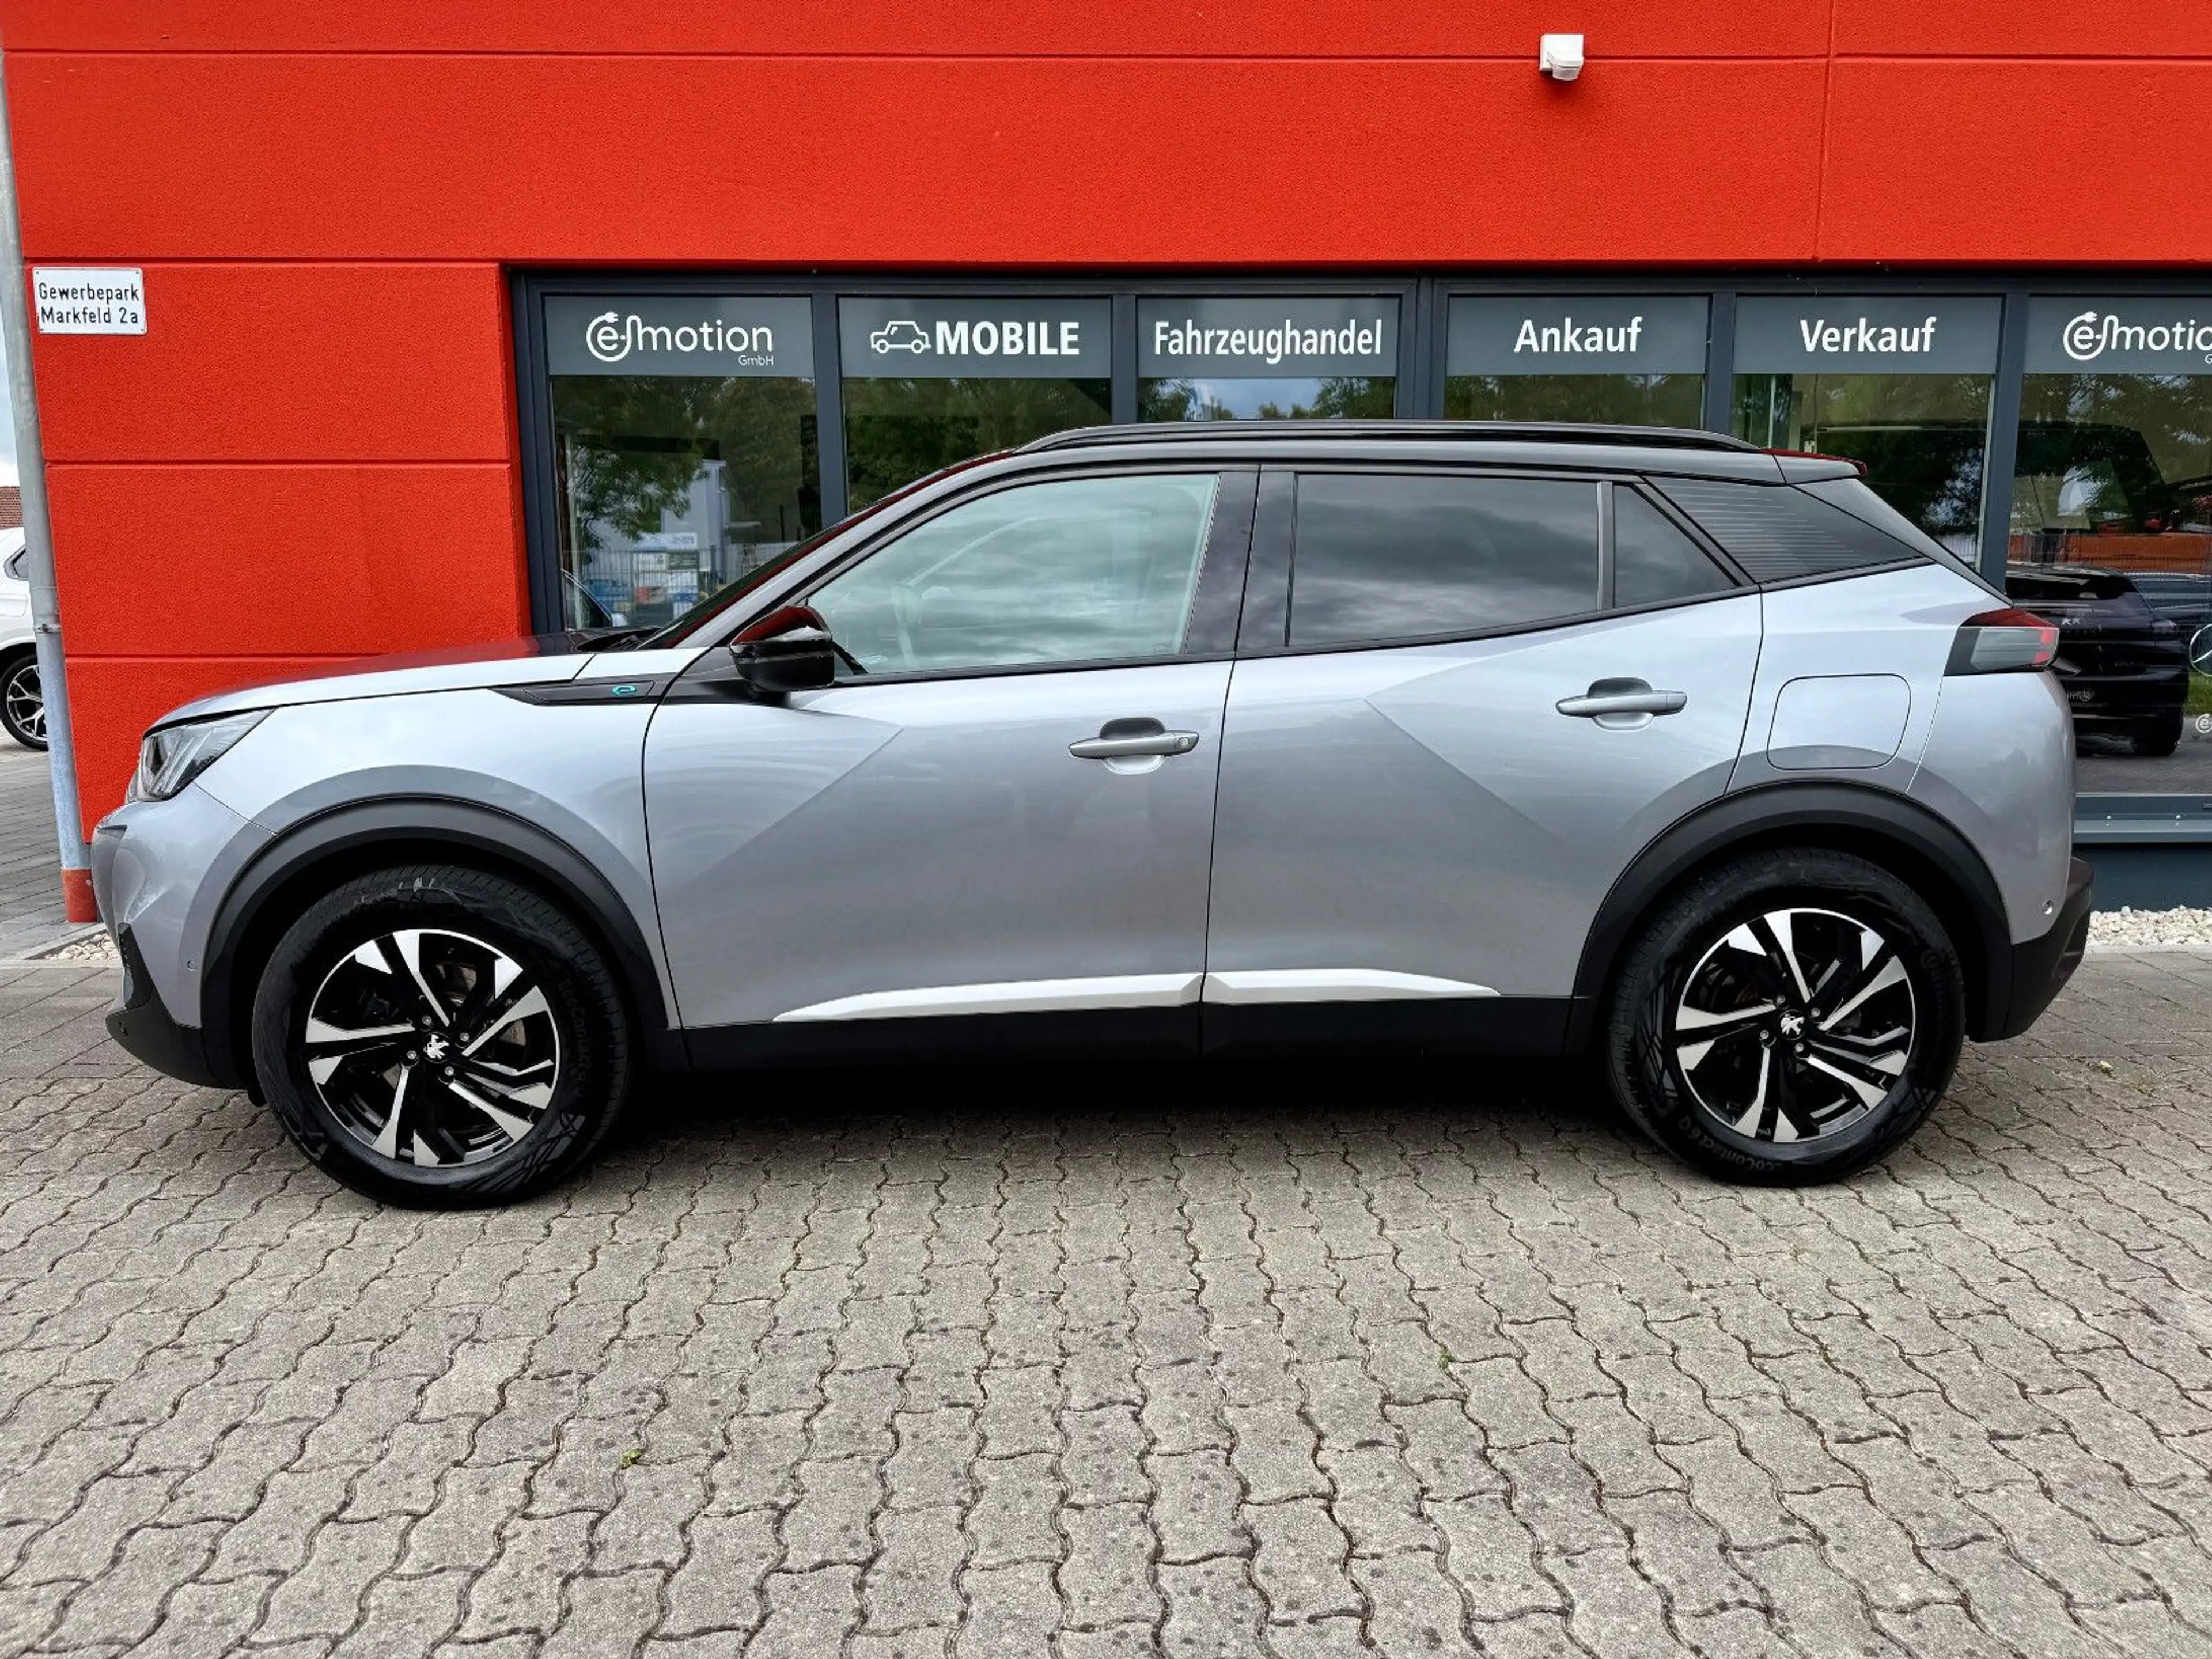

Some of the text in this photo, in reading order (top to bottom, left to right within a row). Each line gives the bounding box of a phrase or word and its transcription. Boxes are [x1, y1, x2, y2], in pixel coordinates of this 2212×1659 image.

[39, 282, 139, 304] Gewerbepark
[41, 306, 138, 324] Markfeld 2a
[936, 321, 1080, 355] MOBILE
[1155, 319, 1382, 365] Fahrzeughandel
[1513, 316, 1642, 353] Ankauf
[1800, 316, 1937, 353] Verkauf
[738, 355, 774, 366] GmbH
